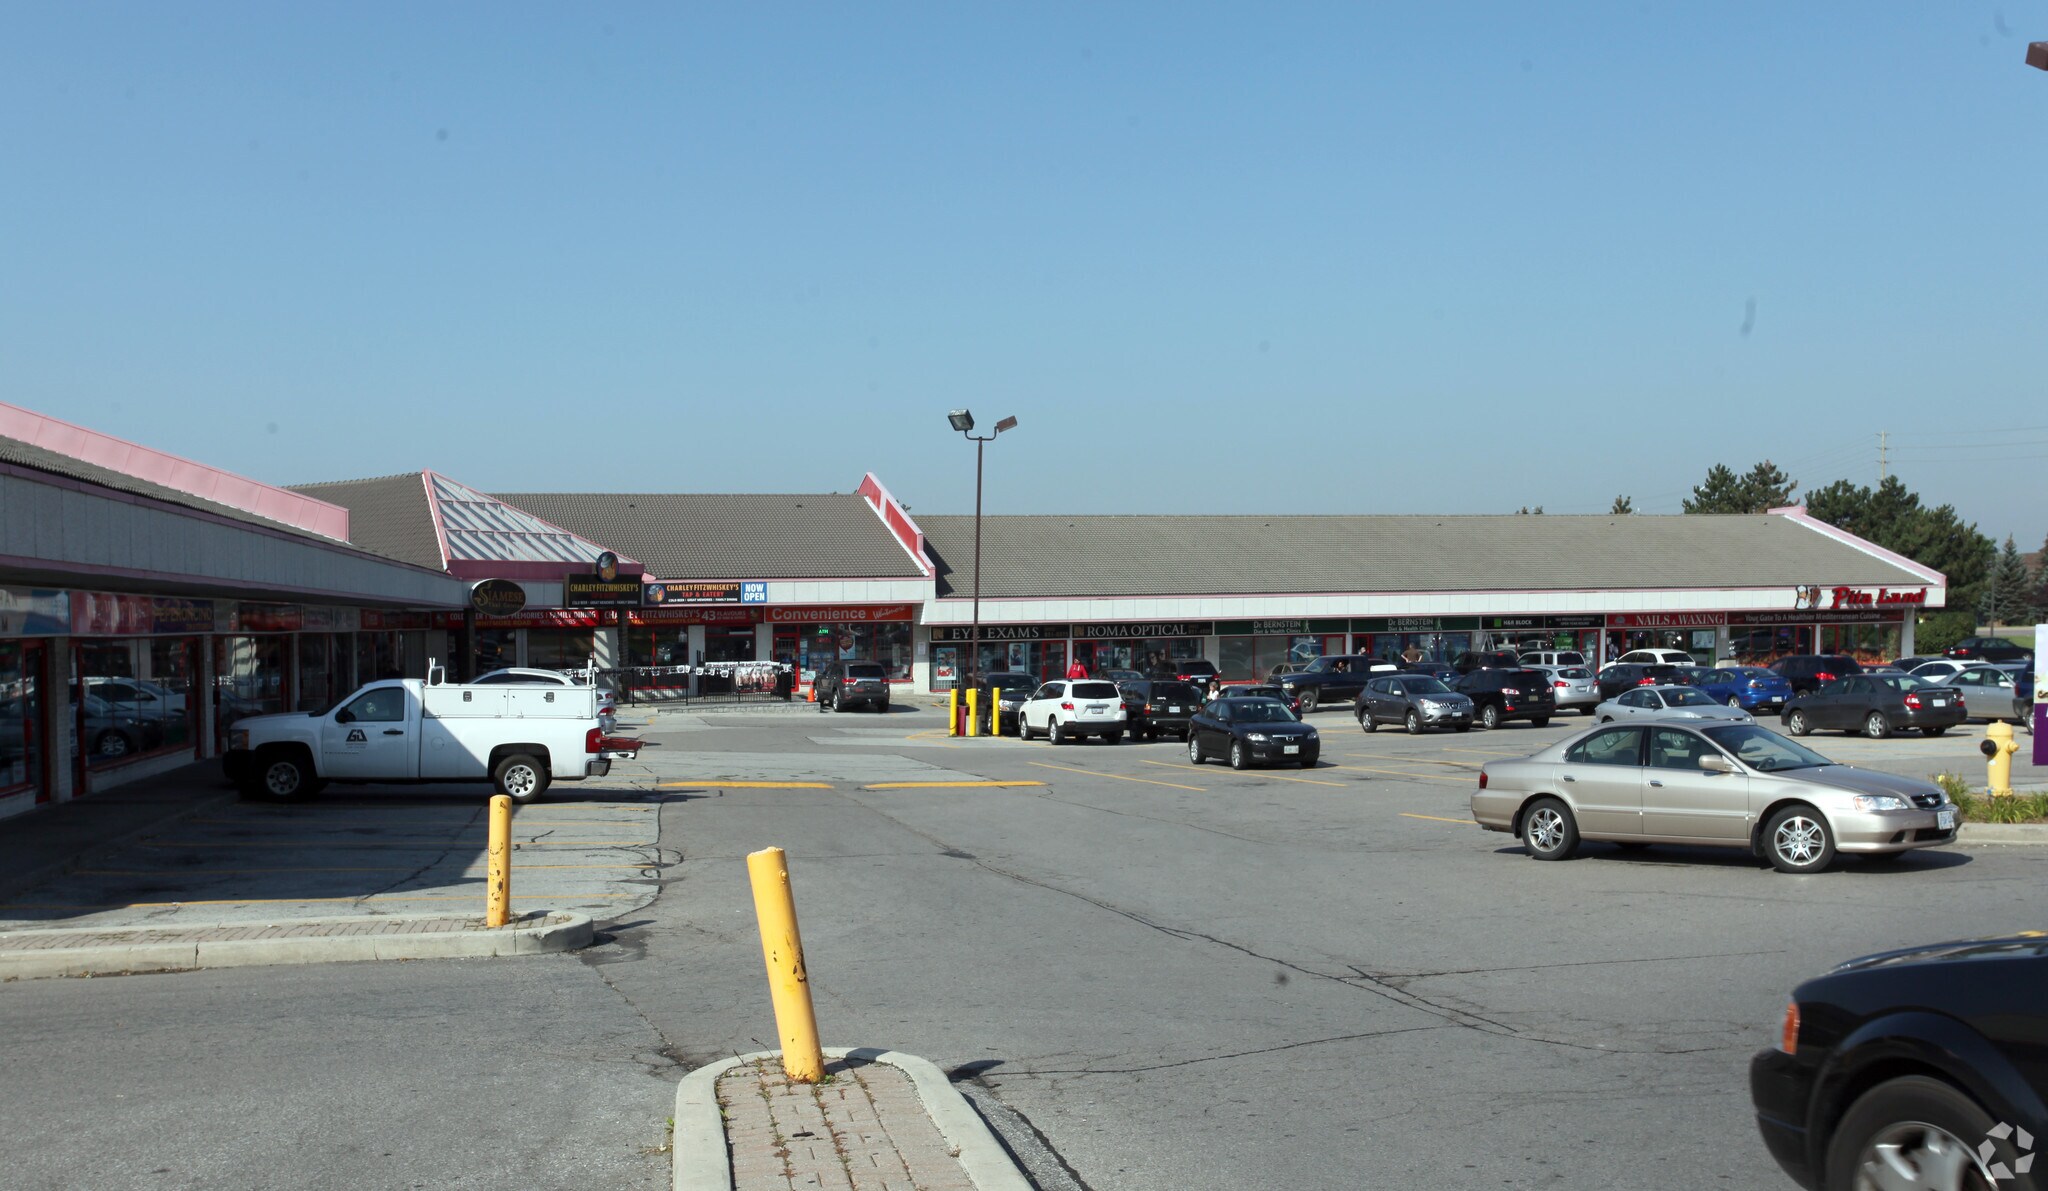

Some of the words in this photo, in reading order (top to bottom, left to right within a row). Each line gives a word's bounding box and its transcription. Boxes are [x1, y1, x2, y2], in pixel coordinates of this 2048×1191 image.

[745, 583, 764, 593] NOW
[744, 592, 765, 602] OPEN
[1832, 587, 1873, 609] Pita
[1876, 587, 1926, 604] Land
[549, 611, 572, 619] FAMILY
[574, 610, 596, 618] DINING
[702, 610, 716, 621] 43
[772, 608, 866, 620] Convenience
[1636, 614, 1670, 626] NAILS
[1678, 613, 1723, 625] WAXING
[1745, 615, 1759, 624] Your
[1788, 613, 1815, 621] Healthier
[1264, 620, 1301, 629] BERNSTEIN
[1398, 617, 1434, 626] BERNSTEIN
[988, 626, 1039, 638] EXAMS
[1087, 625, 1128, 637] ROMA
[1131, 624, 1187, 636] OPTICAL
